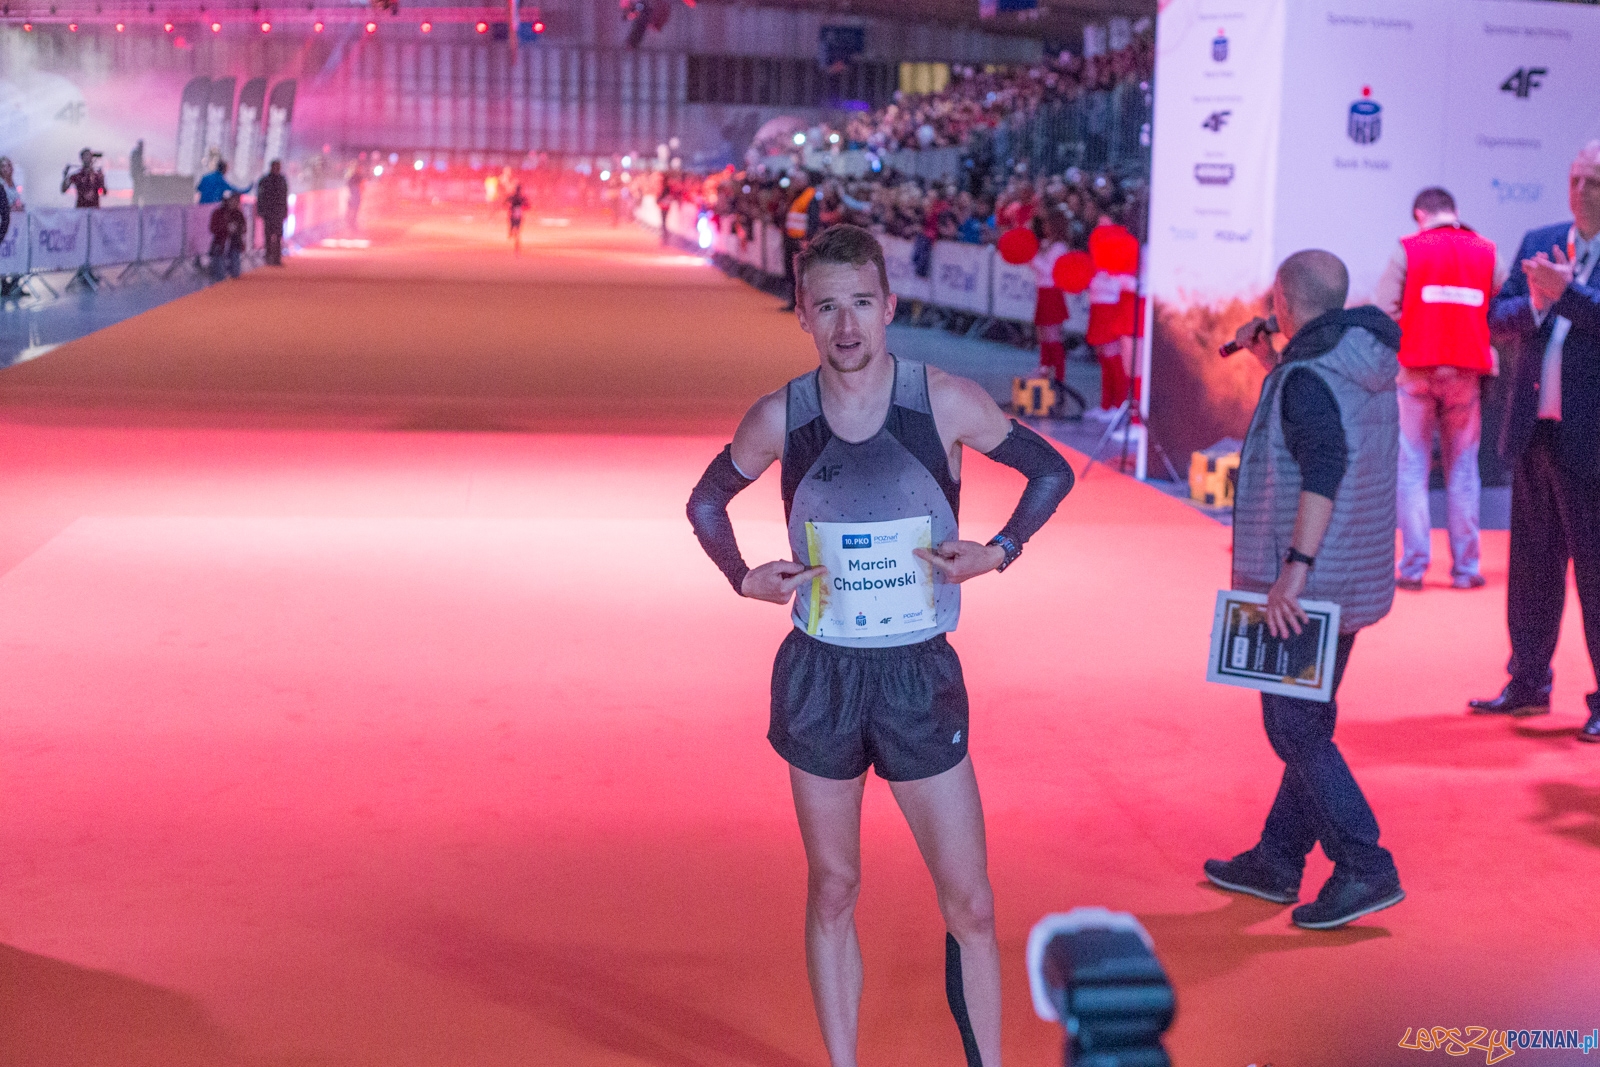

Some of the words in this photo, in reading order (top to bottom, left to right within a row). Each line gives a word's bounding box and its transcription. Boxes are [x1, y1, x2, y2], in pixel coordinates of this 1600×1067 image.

[1500, 67, 1548, 98] 4F
[811, 464, 843, 482] 4F
[854, 537, 870, 545] PKO
[848, 557, 897, 571] Marcin
[833, 571, 916, 591] Chabowski
[879, 616, 892, 624] 4F
